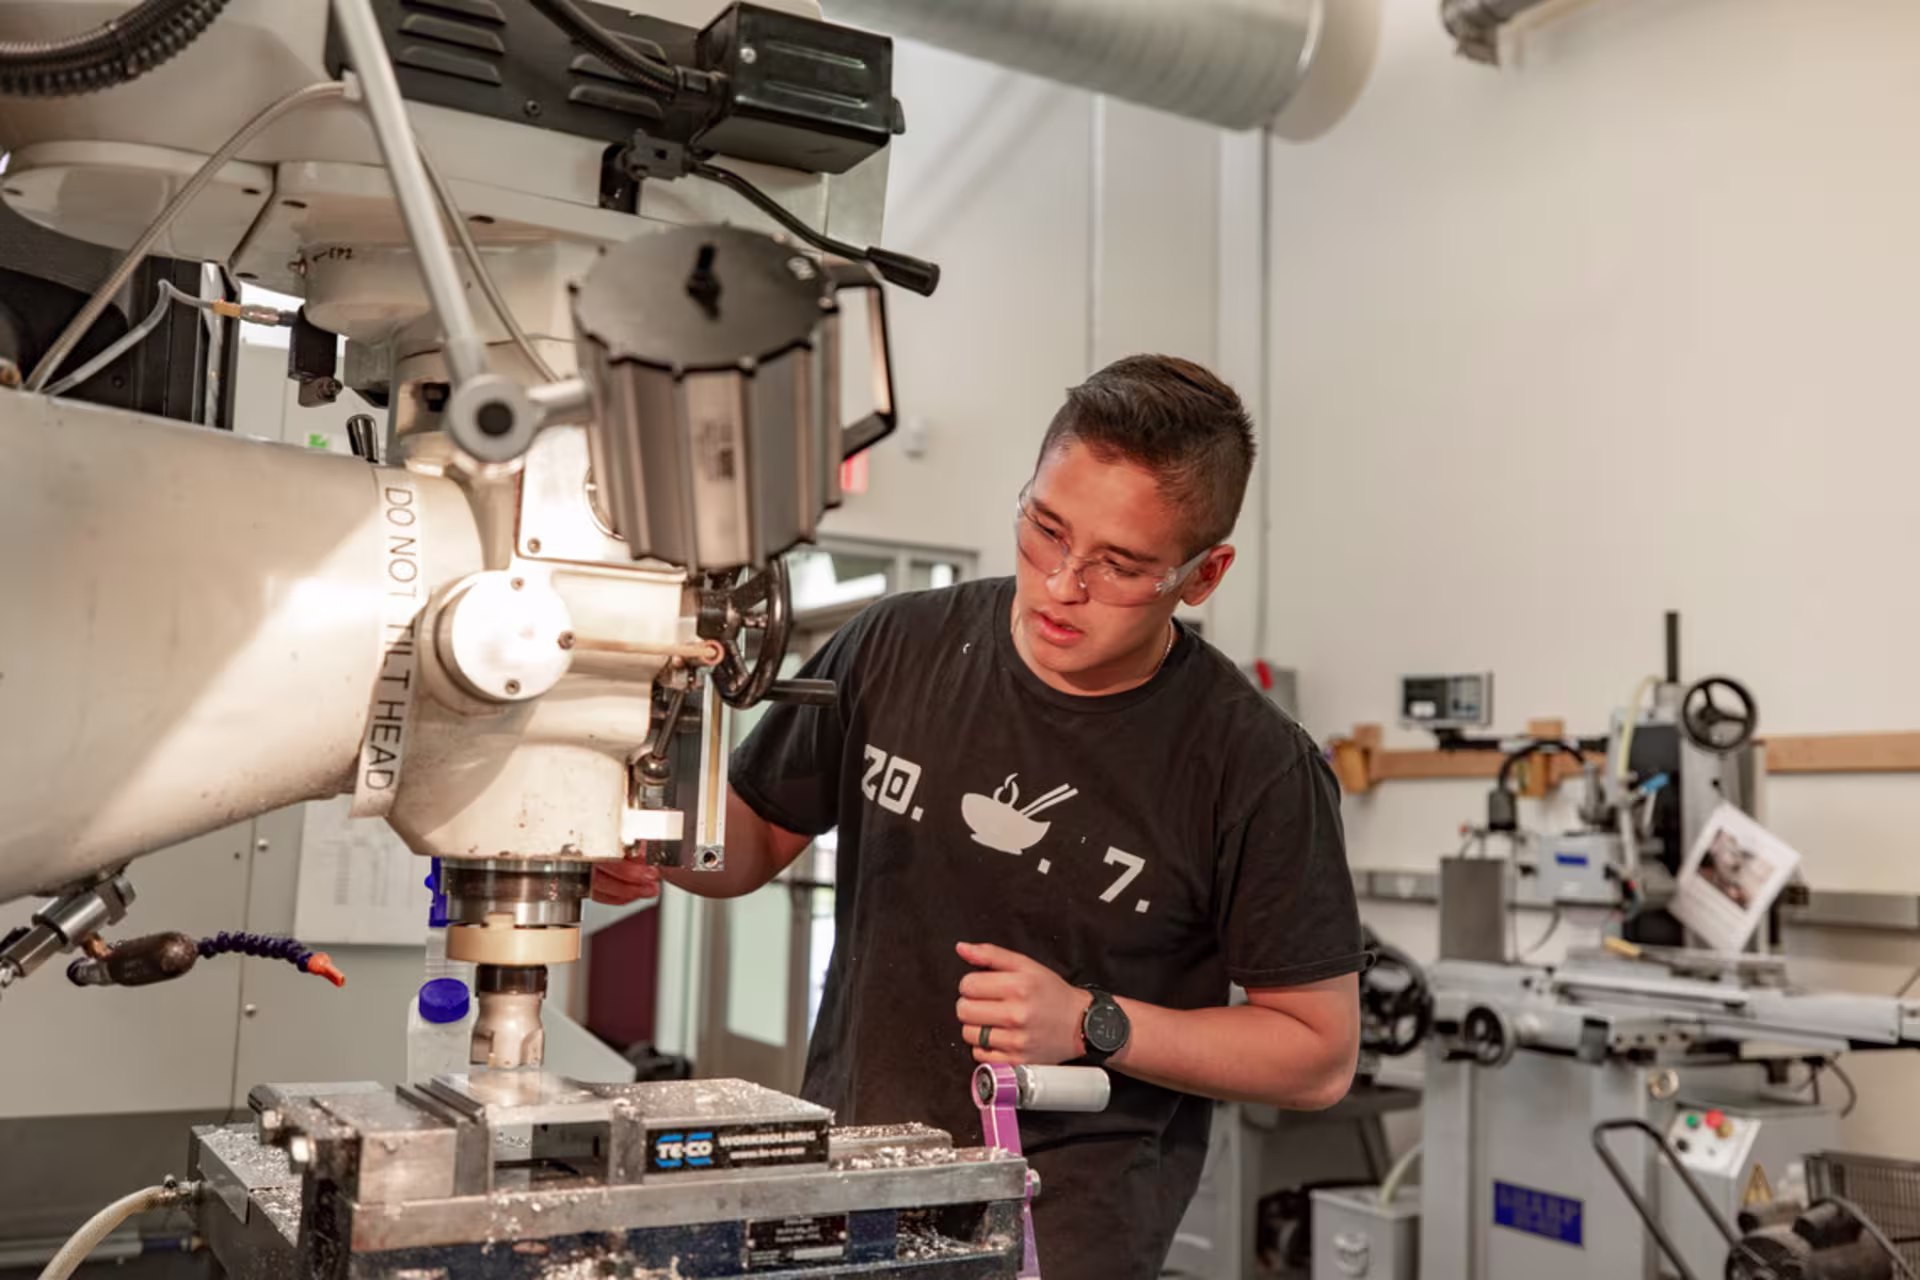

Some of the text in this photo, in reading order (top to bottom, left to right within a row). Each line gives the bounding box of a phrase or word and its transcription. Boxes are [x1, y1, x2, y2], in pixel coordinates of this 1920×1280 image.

[365, 487, 418, 791] DO NOT TILT HEAD
[719, 1131, 817, 1147] WORKHOLDING
[656, 1140, 713, 1160] TE-CO
